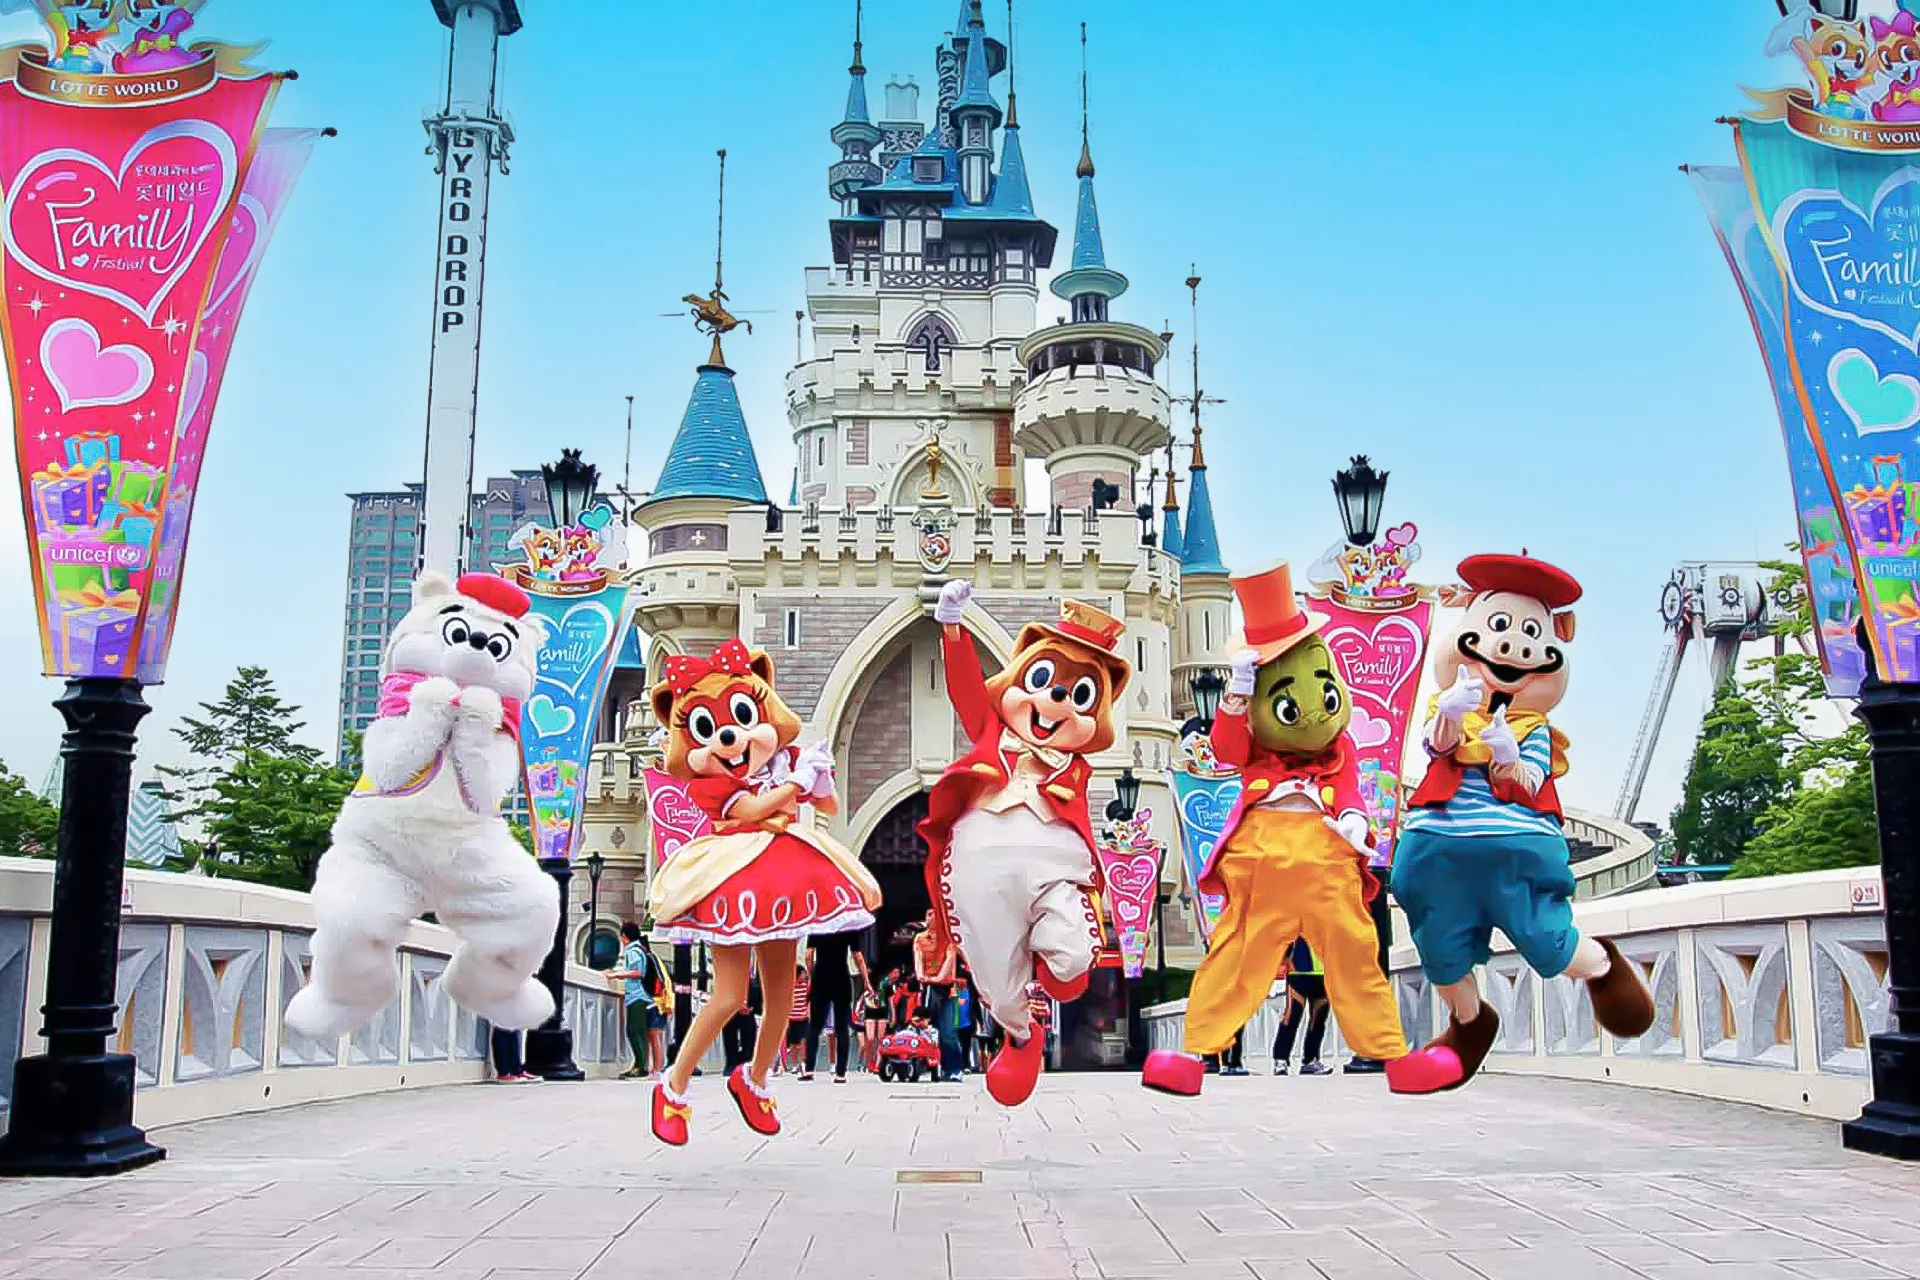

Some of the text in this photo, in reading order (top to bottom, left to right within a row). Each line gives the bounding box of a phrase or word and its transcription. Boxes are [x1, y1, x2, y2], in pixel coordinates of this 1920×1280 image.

[50, 78, 180, 97] LOTTE WORLD
[1818, 121, 1872, 142] LOTTE
[45, 187, 195, 274] Family
[442, 129, 475, 333] GYRO DROP
[51, 543, 113, 562] unicef
[540, 641, 594, 674] amily
